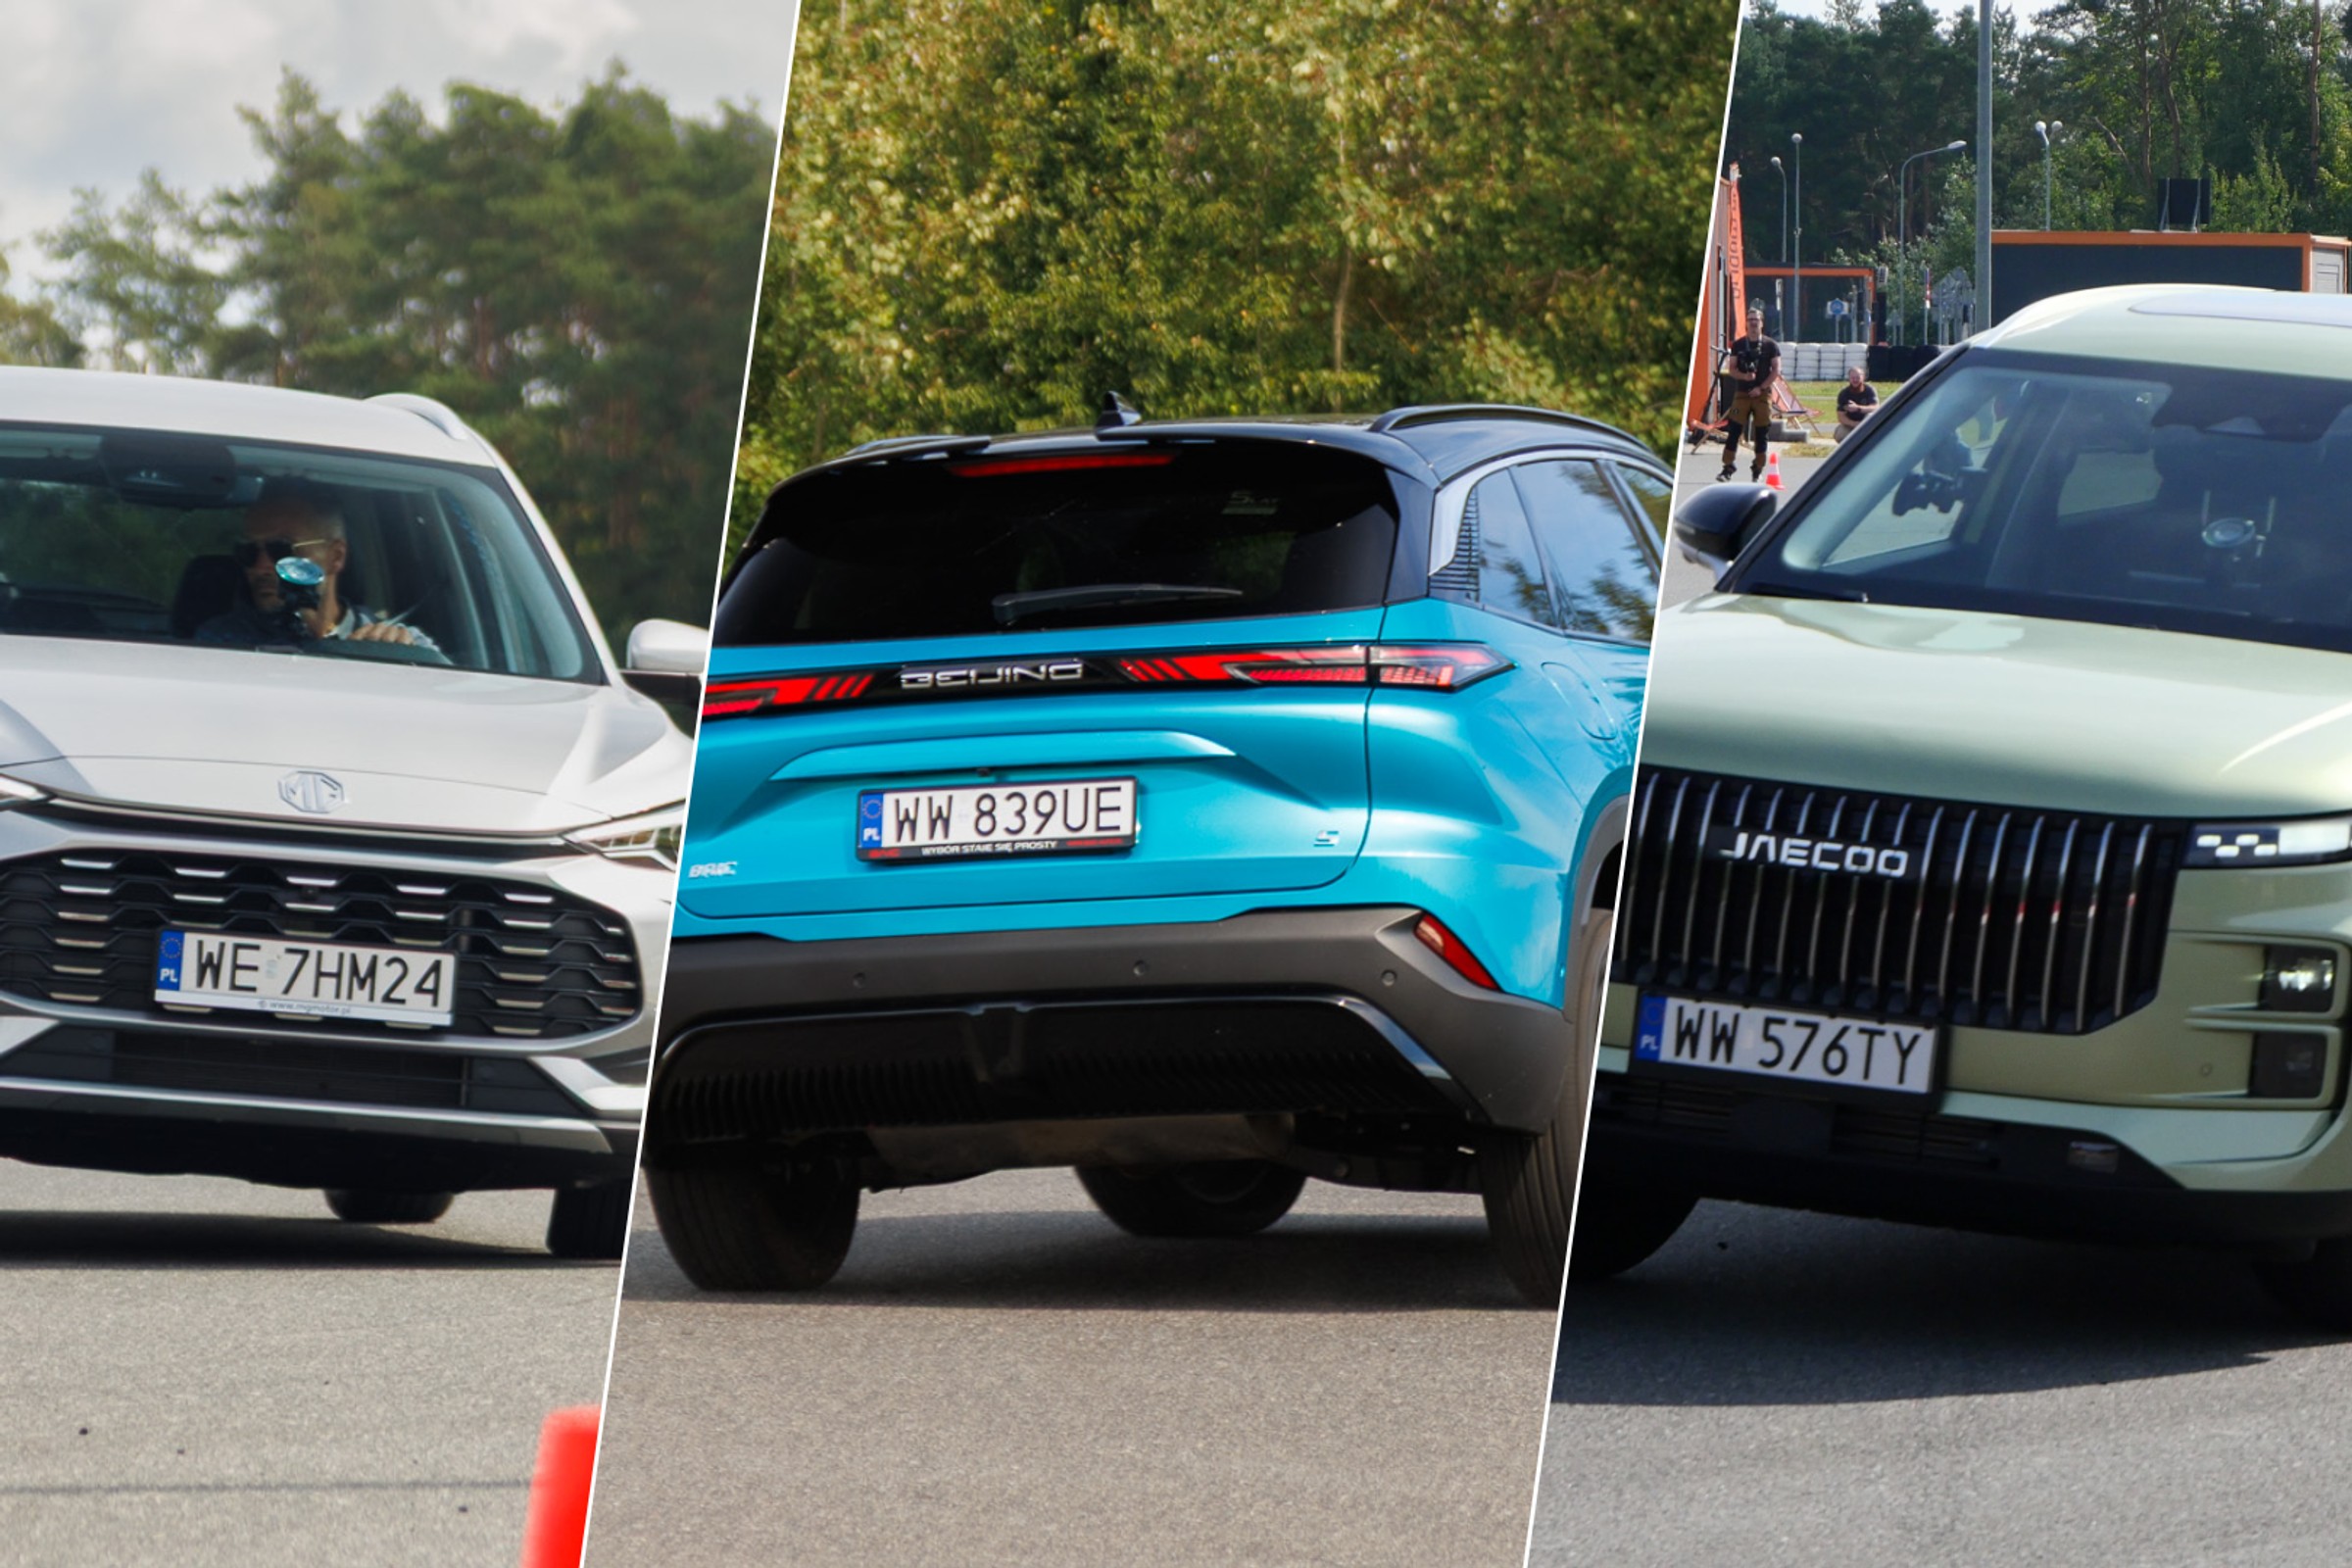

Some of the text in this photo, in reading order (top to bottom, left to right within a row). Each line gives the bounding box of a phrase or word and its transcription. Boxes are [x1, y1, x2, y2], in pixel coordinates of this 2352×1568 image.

[901, 662, 1083, 690] BEIJING
[895, 786, 1122, 843] WW 839UE
[862, 827, 880, 842] PL
[1719, 832, 1909, 878] JAECOO
[159, 966, 178, 983] PL
[196, 939, 443, 1008] WE 7HM24
[1640, 1033, 1659, 1051] PL
[1674, 1004, 1922, 1086] WW 576TY
